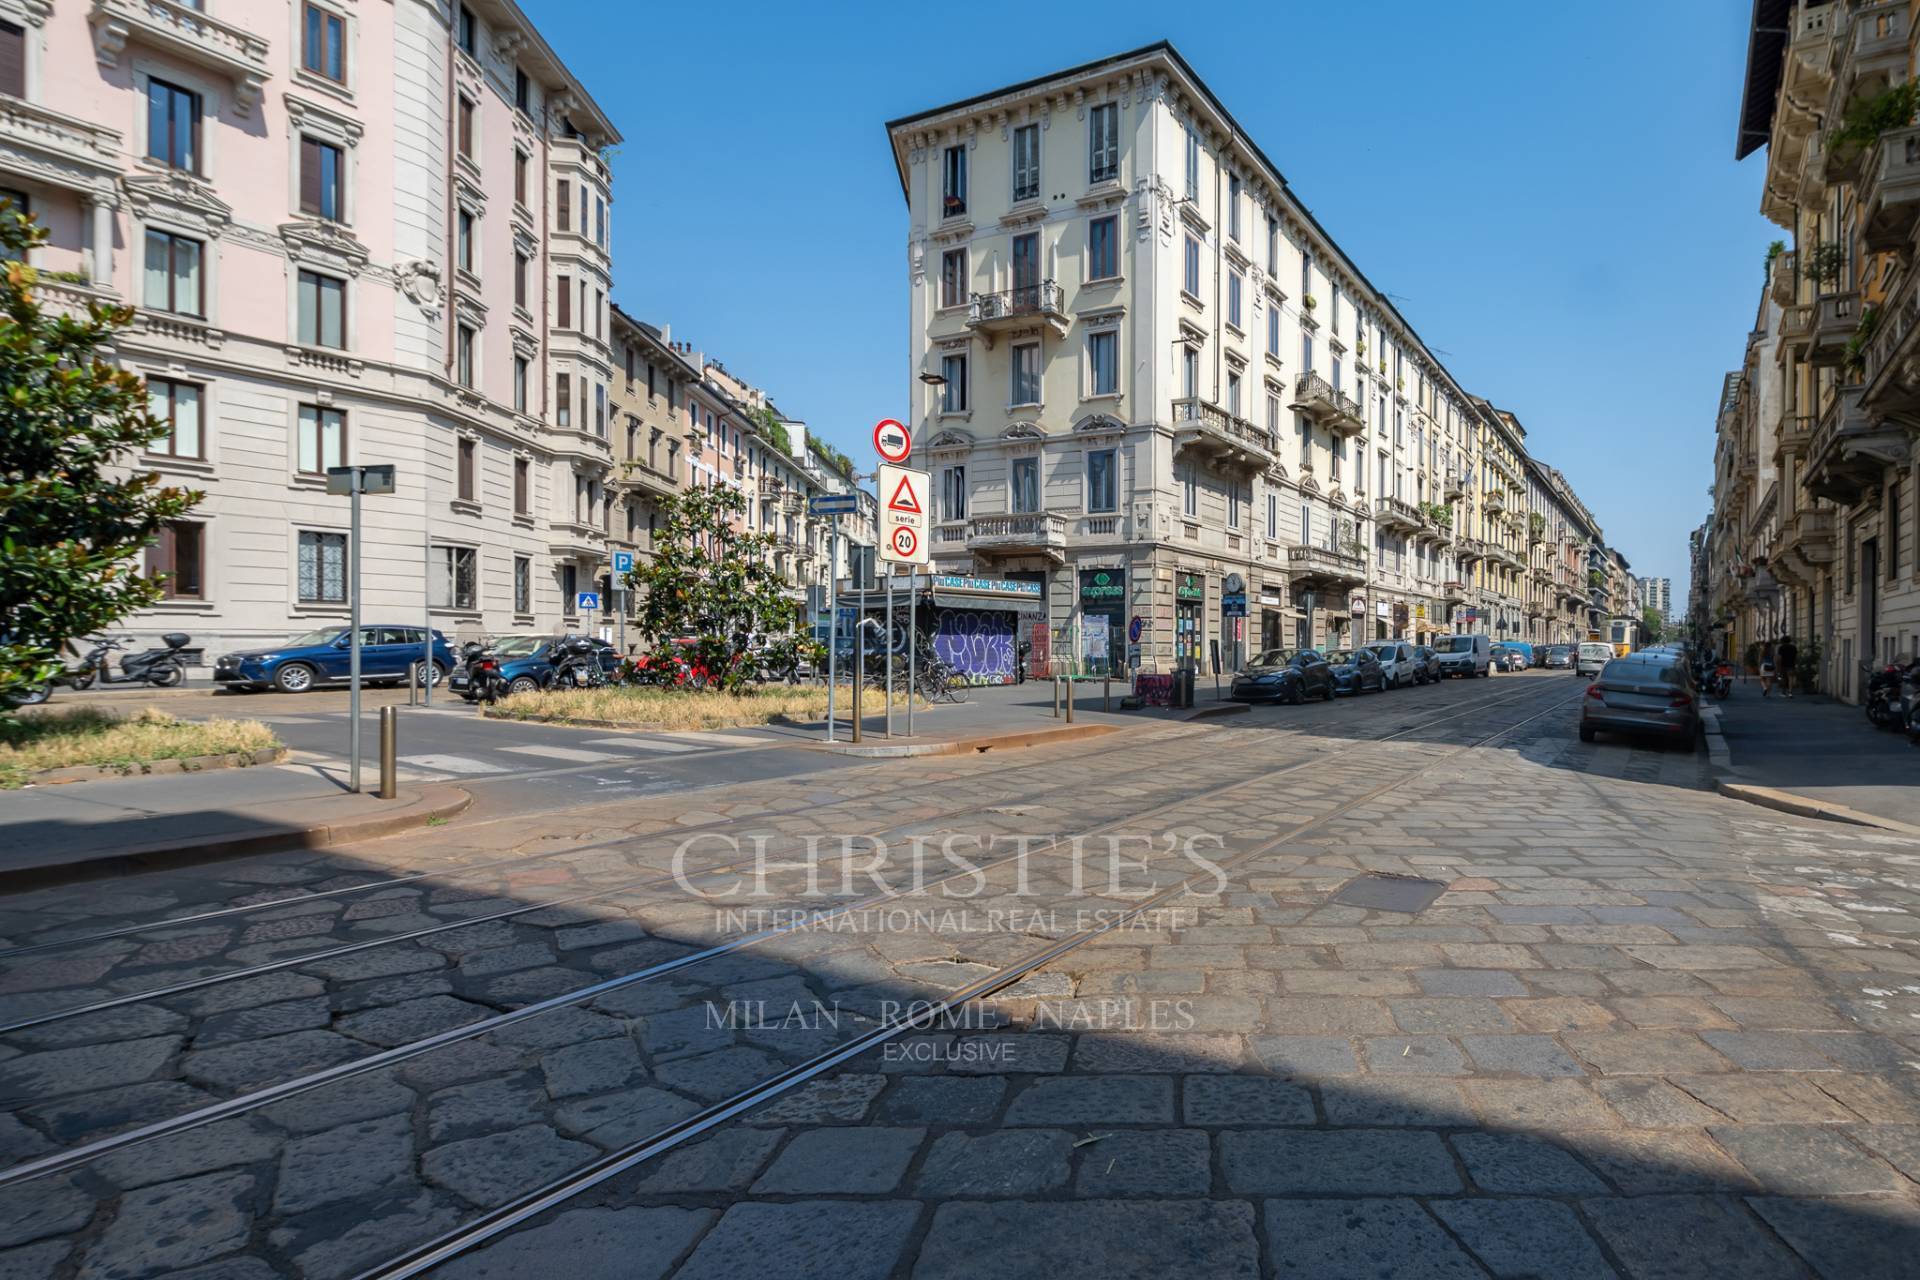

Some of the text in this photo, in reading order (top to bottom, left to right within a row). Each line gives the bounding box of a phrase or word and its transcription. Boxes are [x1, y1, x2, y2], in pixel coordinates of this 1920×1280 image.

[895, 515, 915, 525] serie
[898, 534, 911, 549] 20
[619, 555, 628, 569] P
[945, 577, 963, 588] CASE
[974, 579, 992, 590] CASE
[1001, 580, 1018, 592] CASE
